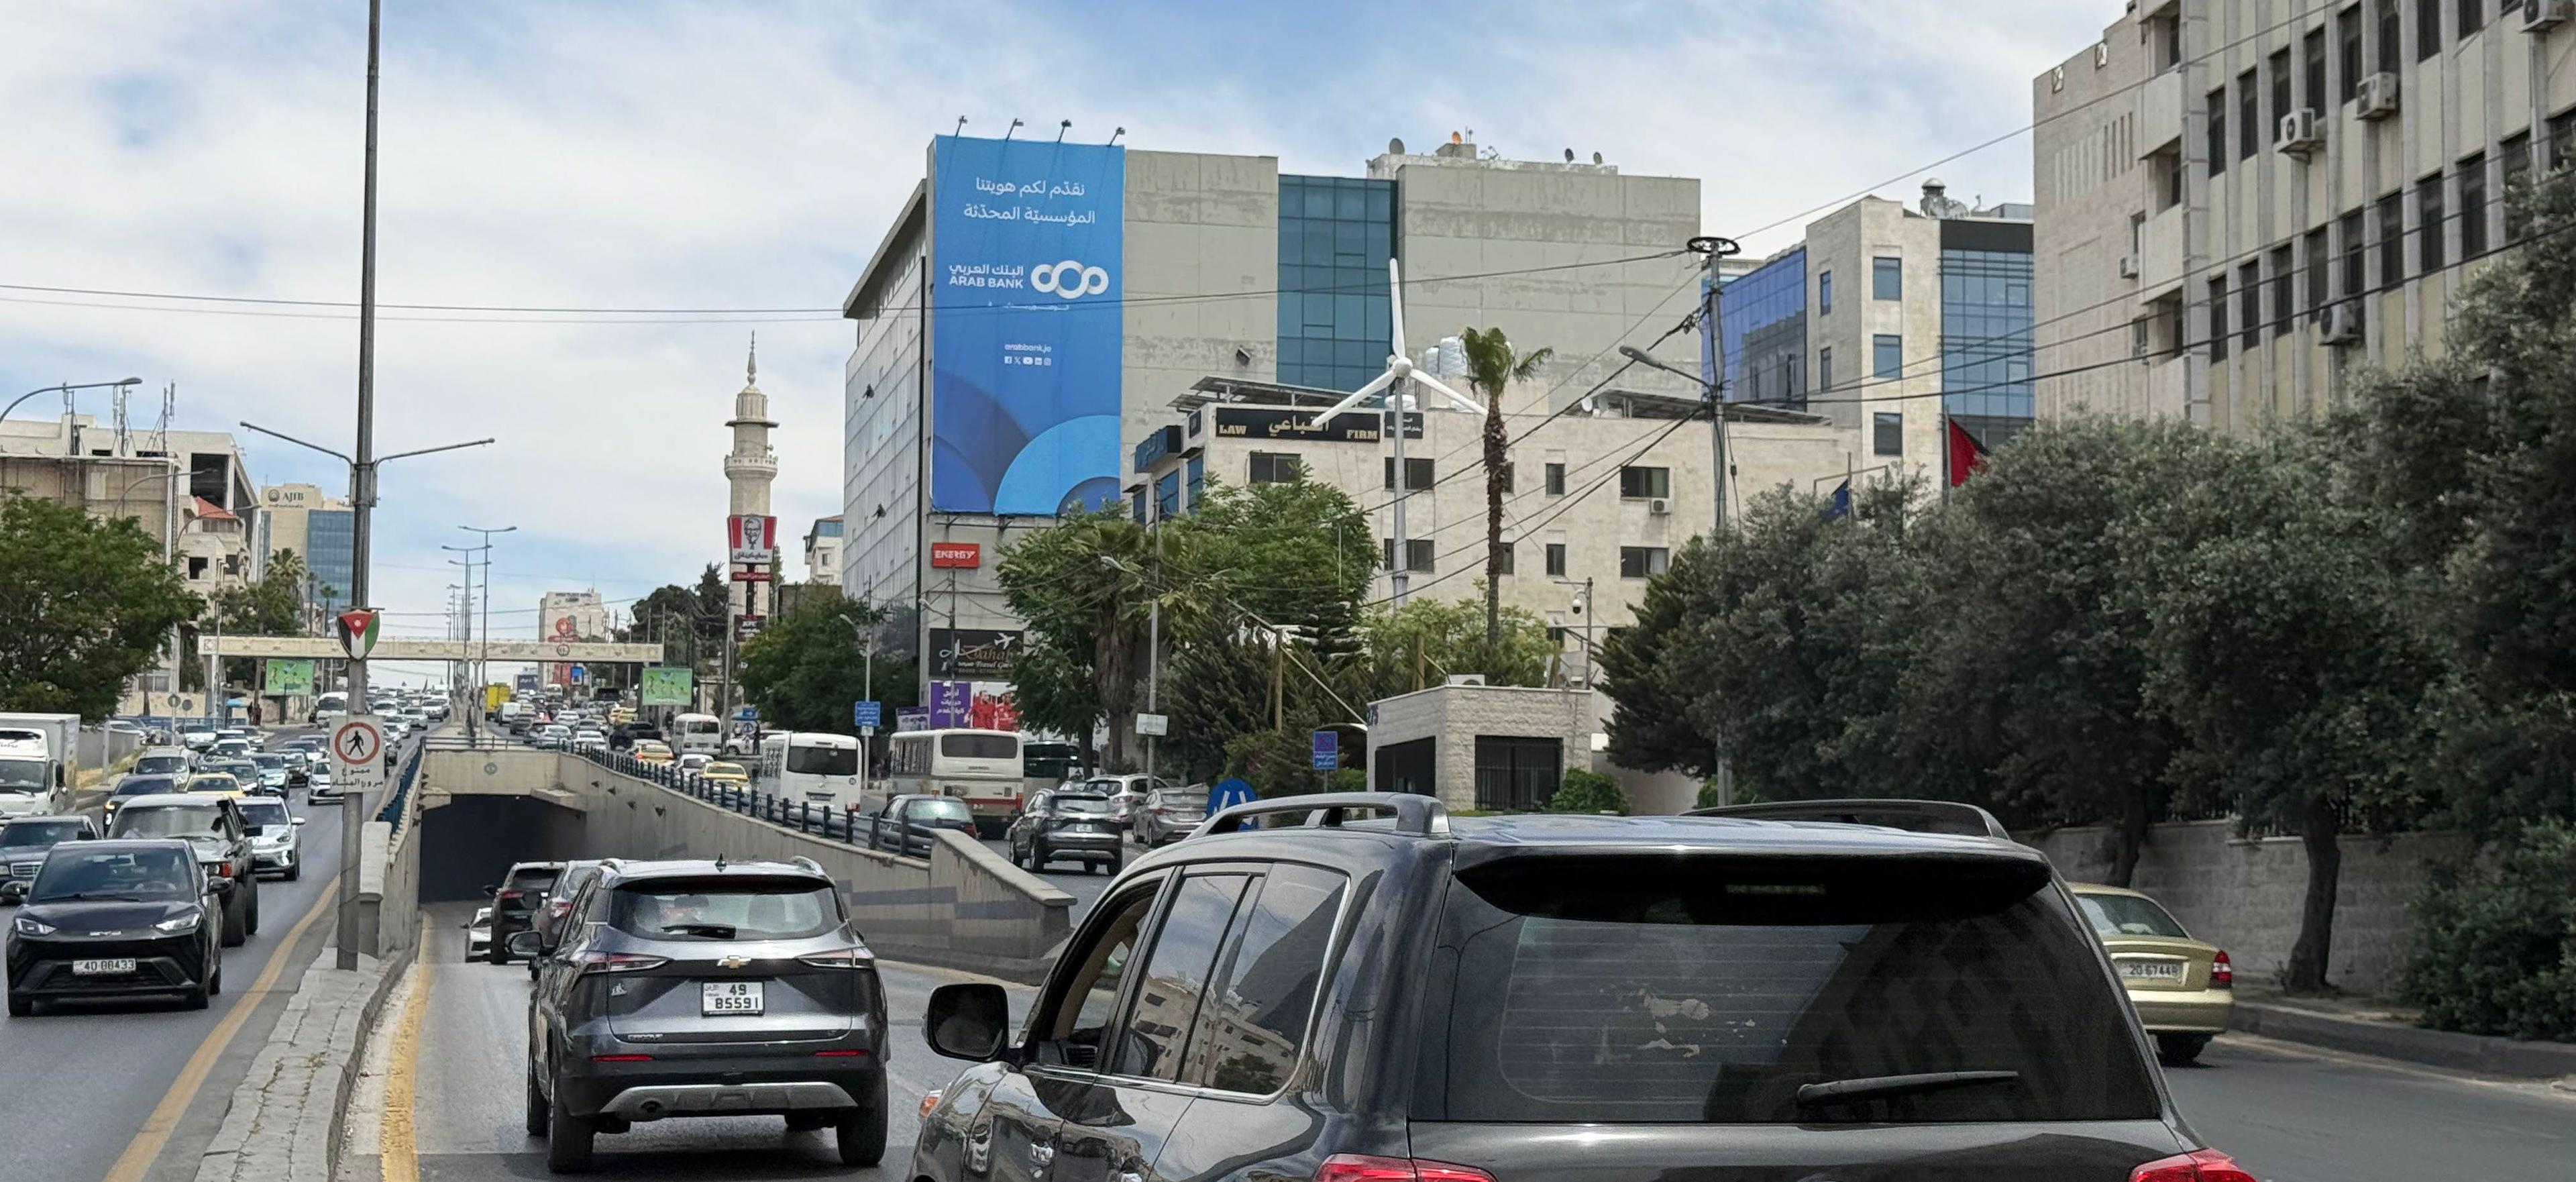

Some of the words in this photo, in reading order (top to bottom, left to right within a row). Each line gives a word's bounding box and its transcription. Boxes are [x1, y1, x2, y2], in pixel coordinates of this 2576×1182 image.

[976, 177, 1016, 195] هويتنا
[1020, 180, 1046, 197] لكم
[949, 264, 989, 275] العربي
[991, 264, 1024, 278] البنك
[949, 276, 985, 287] ARAB
[988, 277, 1024, 289] BANK
[1004, 343, 1052, 353] arabbank.jo
[1219, 425, 1246, 435] LAW
[1346, 429, 1378, 439] FIRM
[934, 550, 976, 559] ENERGY
[729, 984, 747, 996] 49
[715, 997, 758, 1010] 85591
